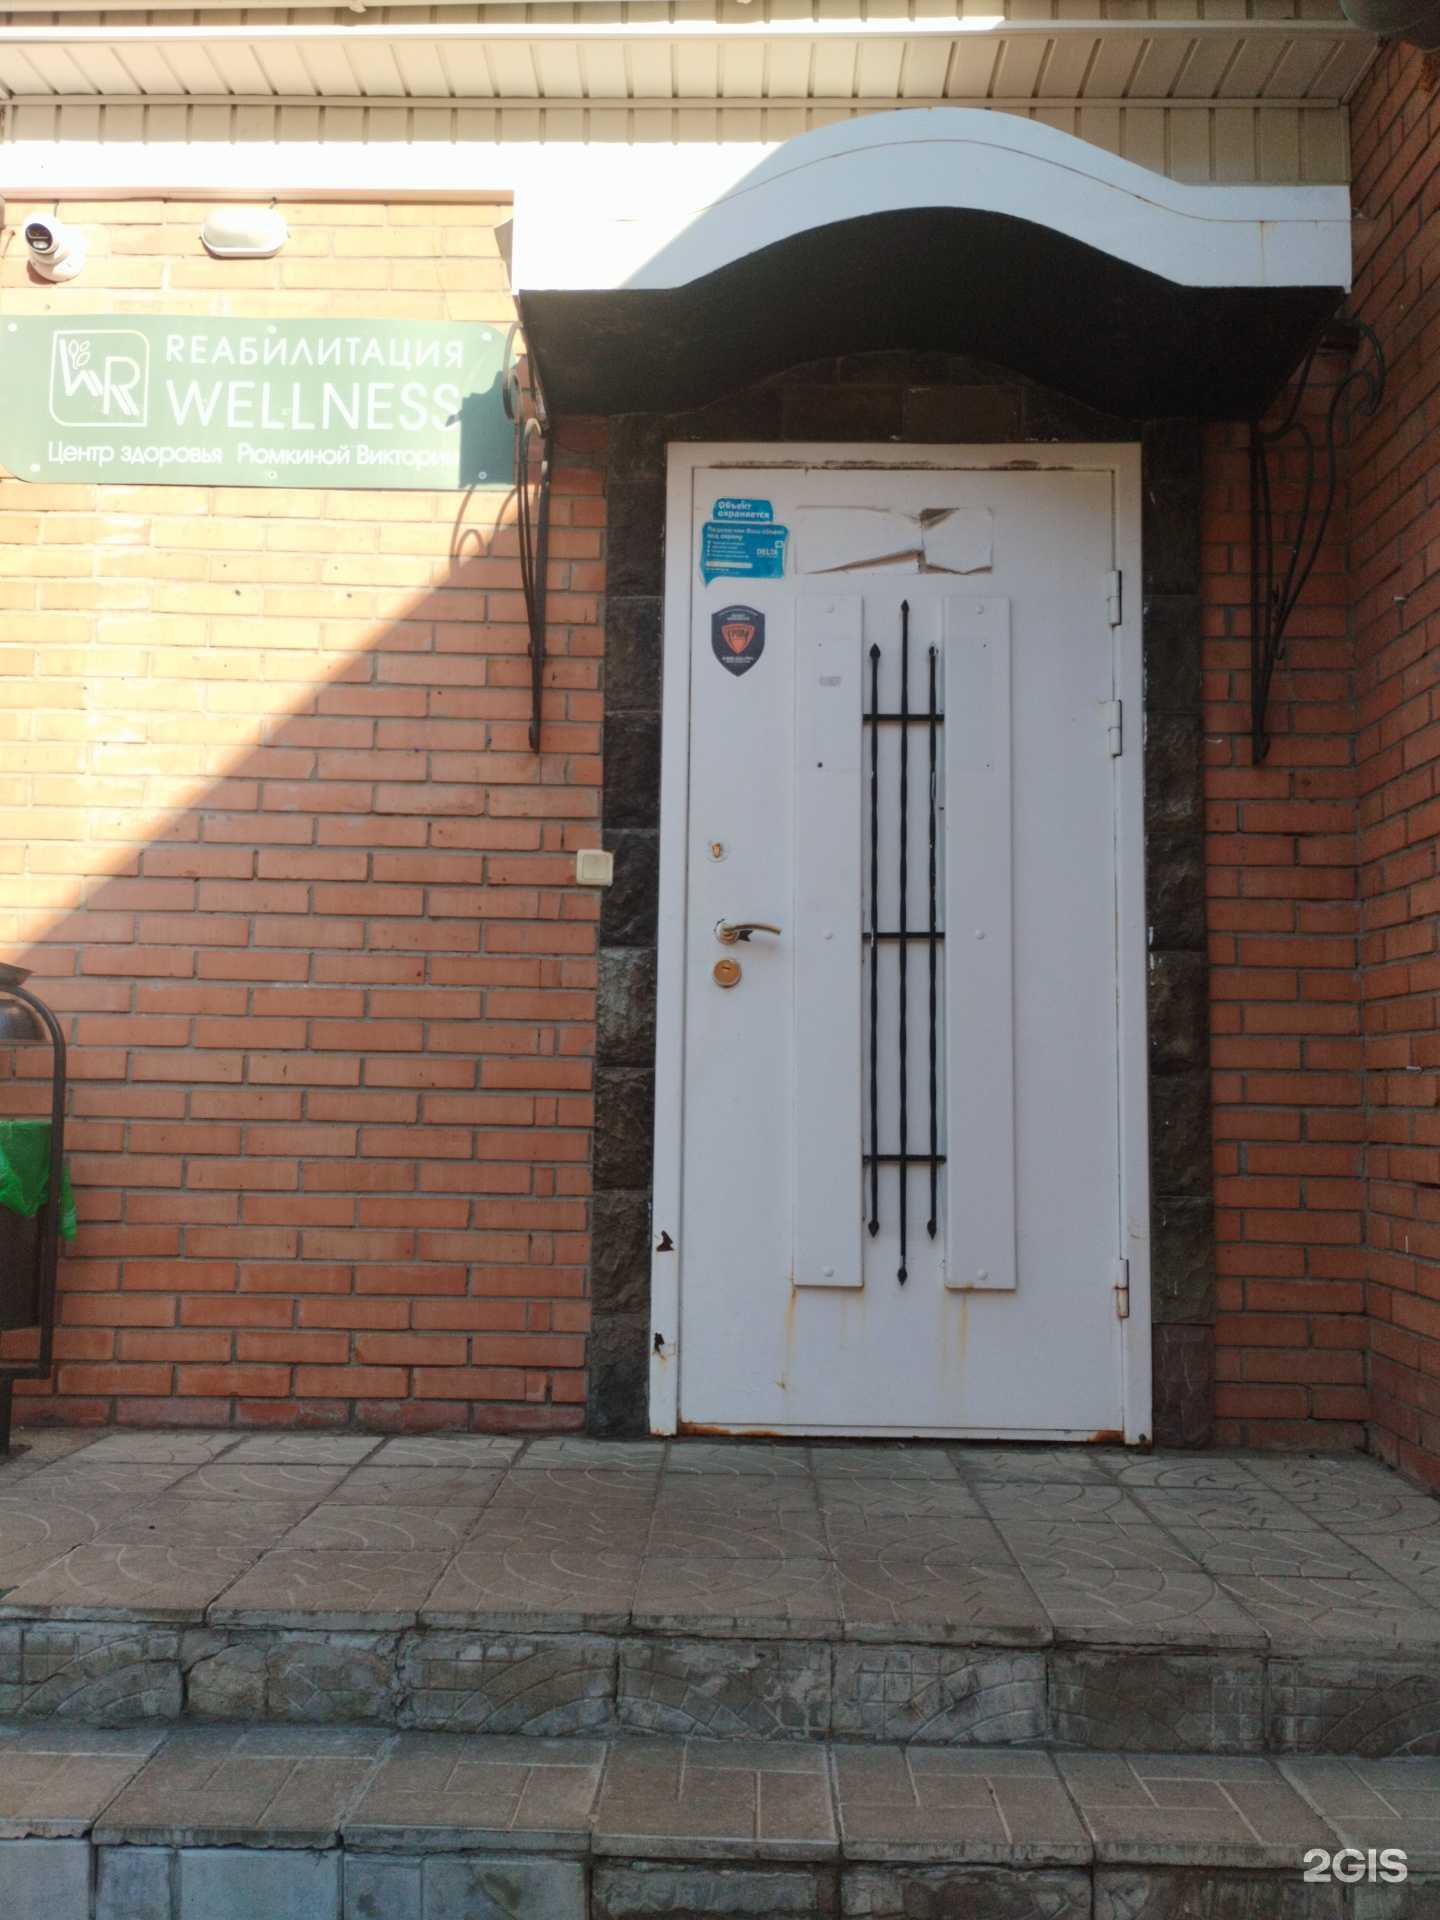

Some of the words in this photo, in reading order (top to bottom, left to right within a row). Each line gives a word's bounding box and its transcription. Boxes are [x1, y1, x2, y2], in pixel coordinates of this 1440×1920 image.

[165, 378, 461, 432] WELLNESS
[47, 440, 115, 468] Центр
[119, 445, 224, 468] здоровья
[236, 442, 351, 466] Рюмкиной
[717, 511, 770, 519] охраняется
[718, 501, 752, 511] Объект
